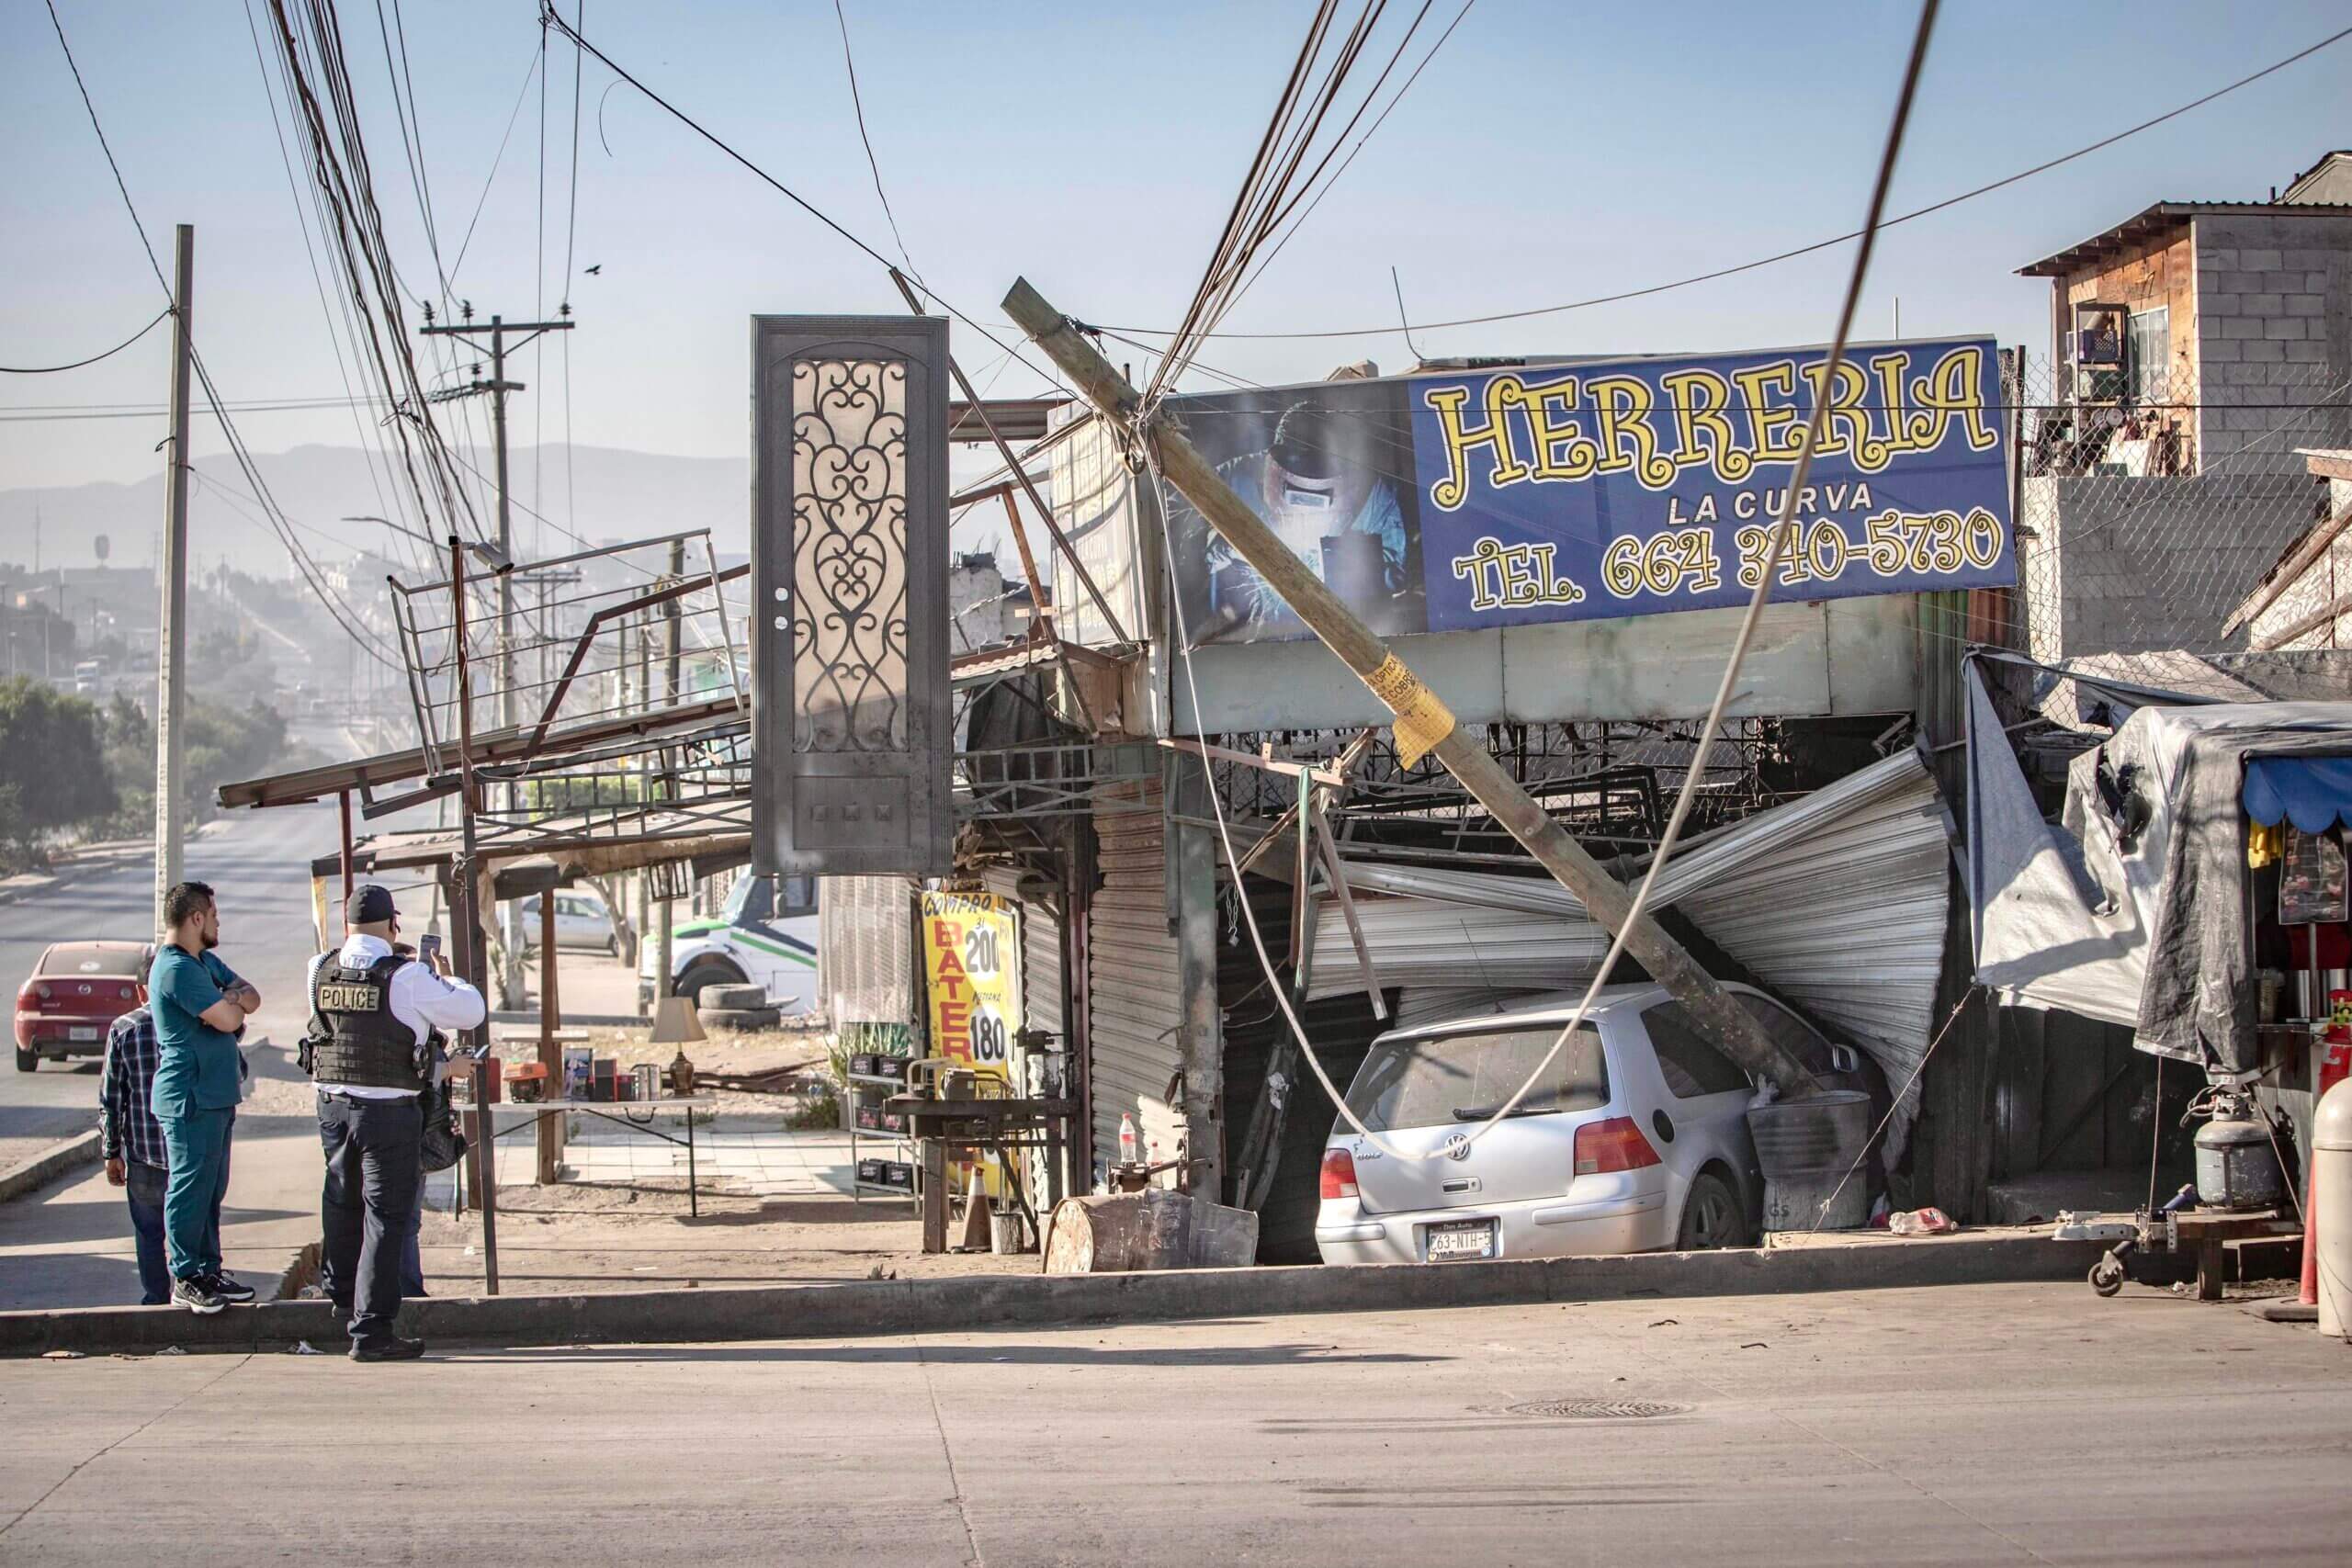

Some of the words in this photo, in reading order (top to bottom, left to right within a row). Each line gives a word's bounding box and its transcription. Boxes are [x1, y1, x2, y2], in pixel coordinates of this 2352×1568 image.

[1425, 345, 1999, 512] HERRERIA
[1668, 495, 1717, 525] LA
[1735, 482, 1873, 519] CURVA
[1453, 536, 1584, 612] TEL.
[1601, 526, 1721, 598] 664
[1735, 506, 2004, 588] 340-5730
[1388, 669, 1415, 699] COBRE
[924, 895, 992, 917] COMPRO
[322, 988, 378, 1009] POLICE
[970, 1015, 1005, 1061] 180
